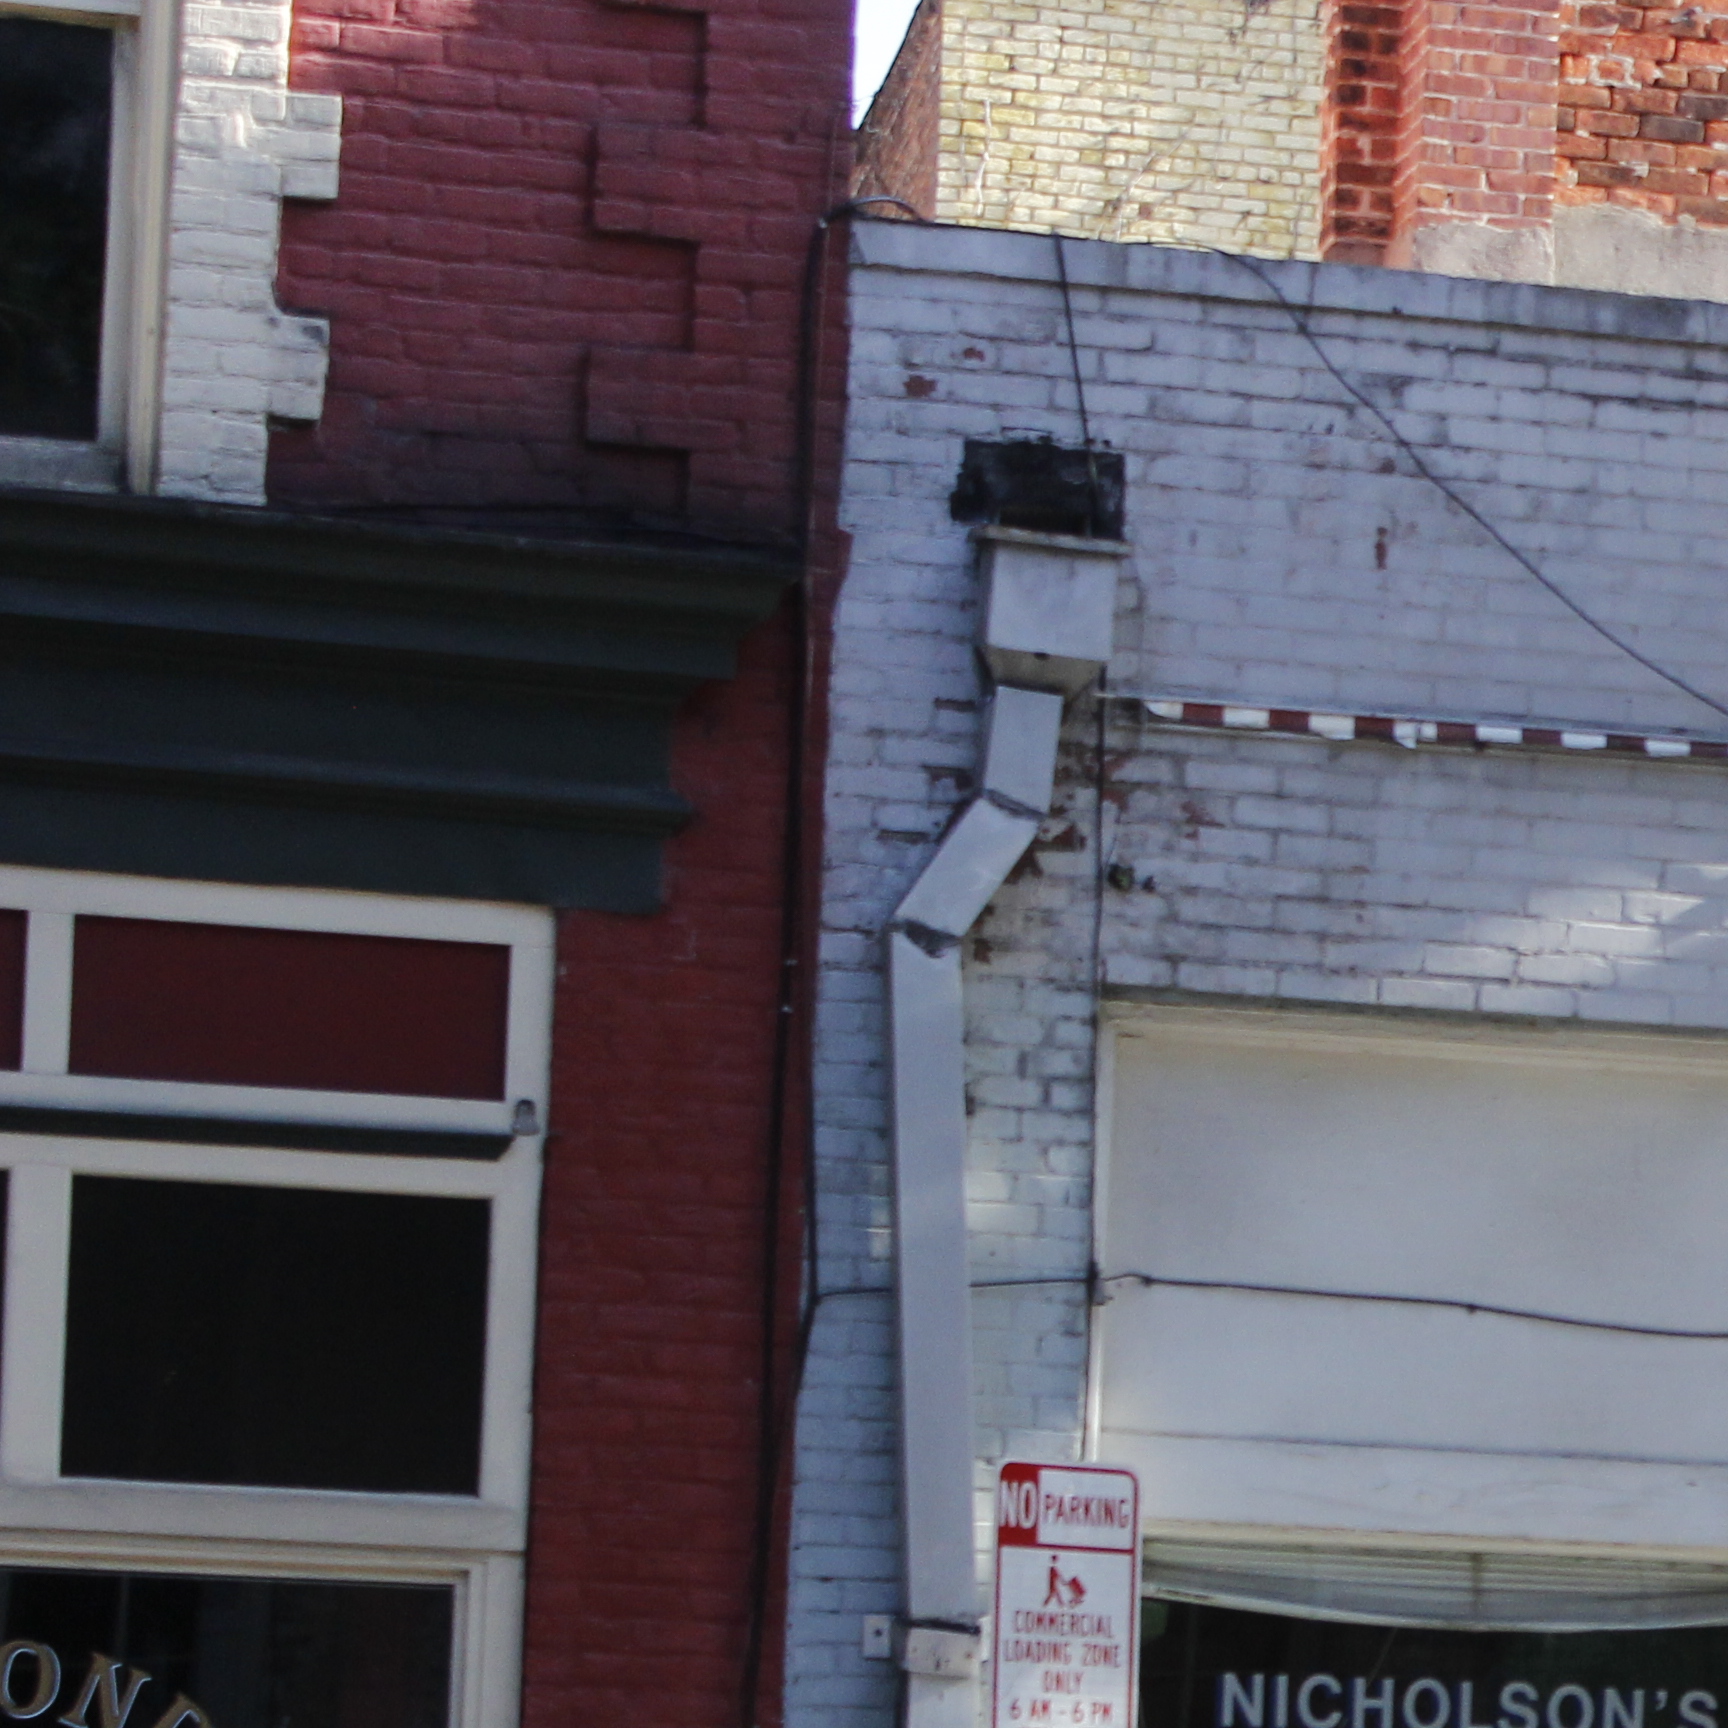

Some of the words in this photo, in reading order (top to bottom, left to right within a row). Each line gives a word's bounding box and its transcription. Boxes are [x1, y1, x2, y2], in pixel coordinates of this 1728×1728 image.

[1000, 1481, 1037, 1529] NO
[1042, 1494, 1131, 1528] PARKING
[1014, 1610, 1114, 1638] COMMERCIAL
[1004, 1640, 1072, 1665] LOADING
[1082, 1643, 1120, 1668] ZONE
[1043, 1671, 1083, 1694] ONLY
[1009, 1698, 1022, 1720] 6
[1030, 1700, 1051, 1722] AM
[1072, 1701, 1085, 1723] 6
[1091, 1702, 1112, 1723] PM
